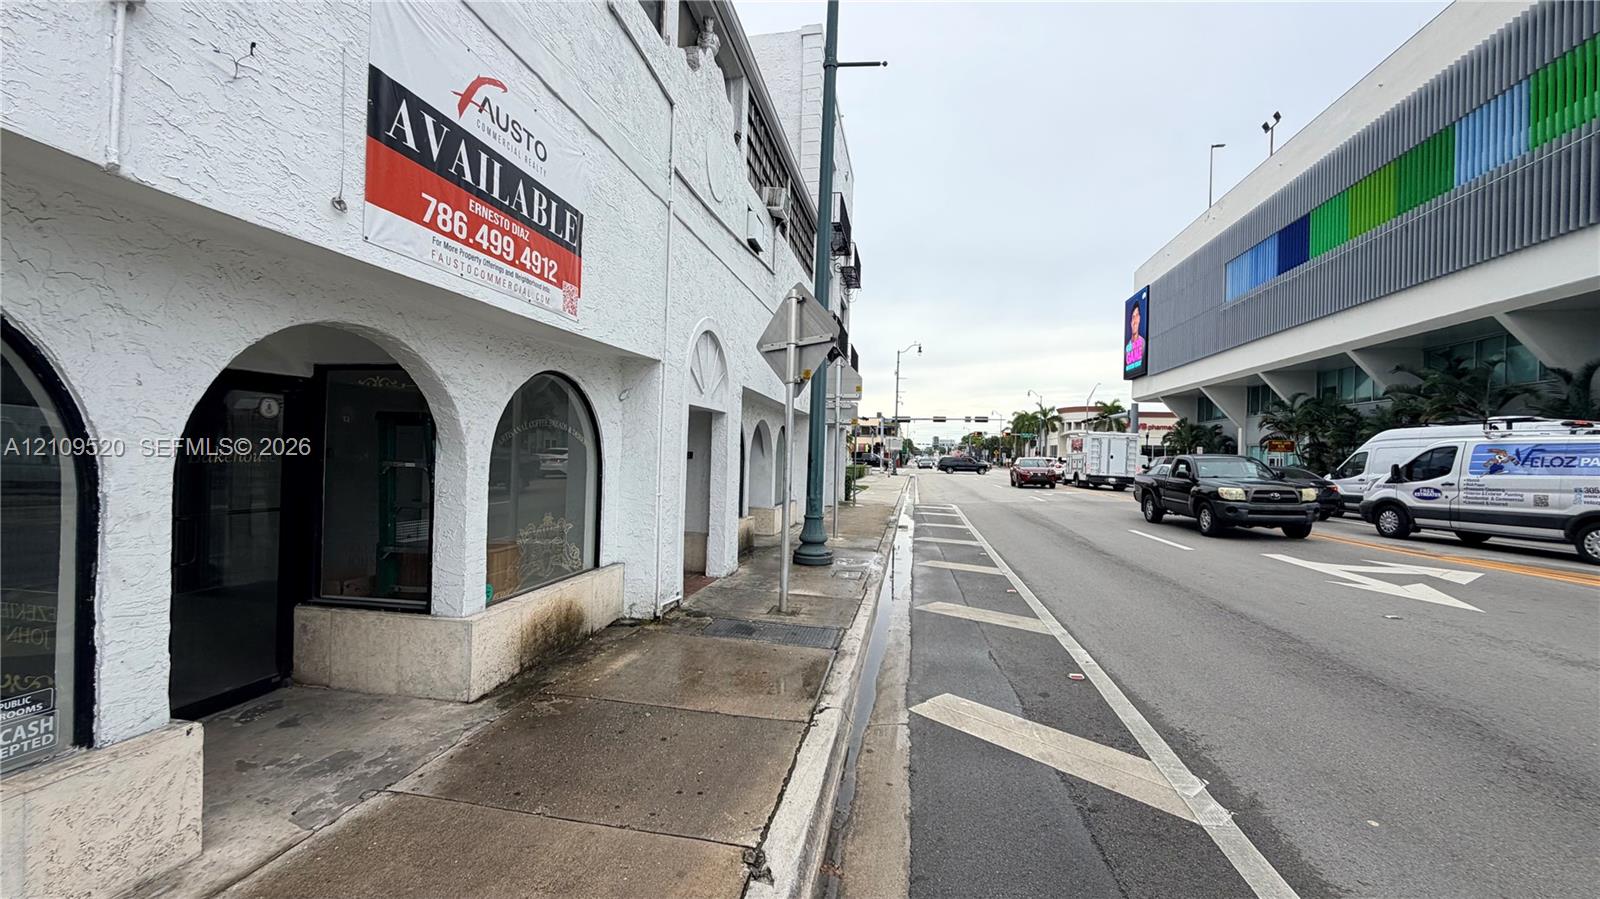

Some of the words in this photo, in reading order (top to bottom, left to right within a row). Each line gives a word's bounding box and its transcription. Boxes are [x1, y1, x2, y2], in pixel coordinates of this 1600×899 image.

[451, 75, 548, 162] FAUSTO
[385, 99, 578, 247] AVAILABLE
[476, 118, 521, 159] COMMERCIAL
[525, 155, 547, 178] REALTY
[421, 192, 558, 283] 786.499.4912
[469, 199, 510, 231] ERNESTO
[512, 223, 530, 242] DIAZ
[431, 249, 551, 305] FAUSTOCOMMERCIAL.COM
[432, 236, 442, 246] For
[443, 240, 459, 254] More
[460, 247, 482, 265] Property
[483, 258, 504, 274] Offerings
[505, 269, 514, 278] and
[1515, 448, 1578, 468] VELOZ
[0, 716, 54, 746] CASH
